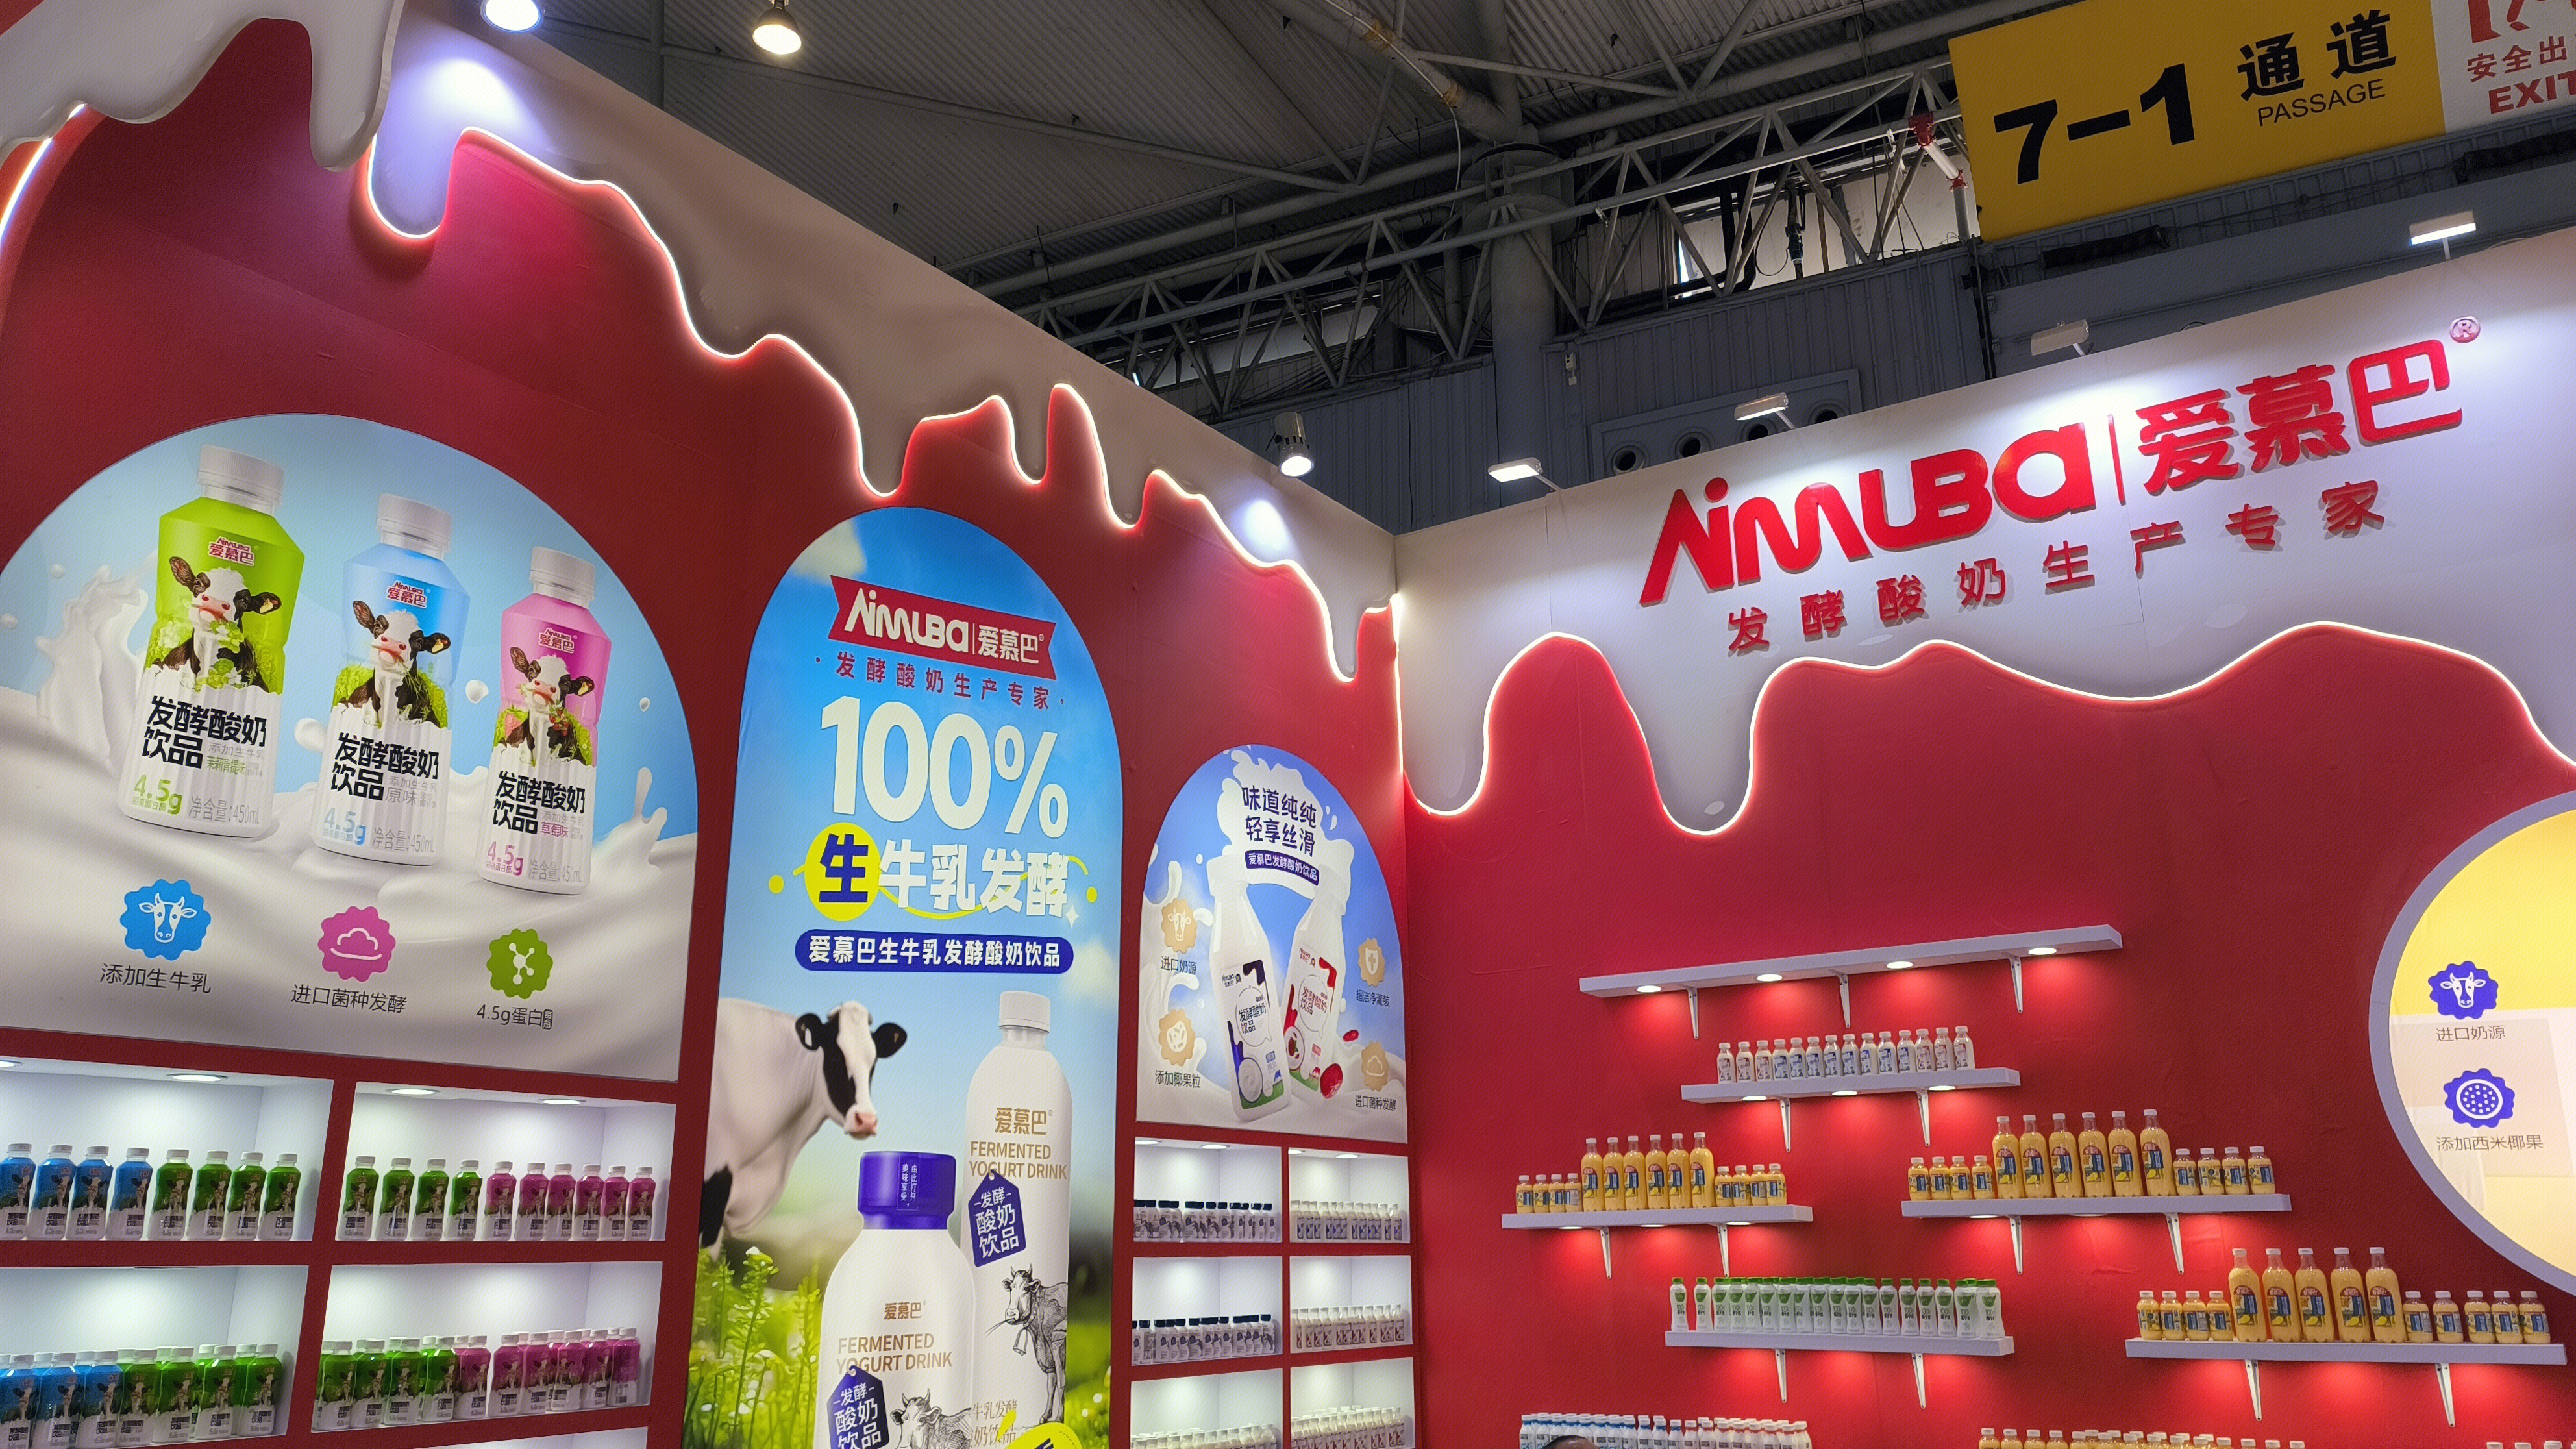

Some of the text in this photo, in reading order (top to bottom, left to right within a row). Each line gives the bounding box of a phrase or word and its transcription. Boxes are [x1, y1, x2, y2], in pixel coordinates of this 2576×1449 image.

[2236, 10, 2397, 102] 通道
[2257, 78, 2386, 126] PASSAGE
[2488, 69, 2576, 114] EXIT
[209, 543, 254, 565] 爱慕巴
[1726, 478, 2386, 656] 发酵酸奶生产专家
[387, 587, 426, 607] 爱慕巴
[835, 651, 1050, 710] 发酵酸奶生产专家
[147, 695, 267, 747] 发酵酸奶
[142, 726, 204, 769] 饮品
[208, 742, 264, 760] 添加生牛乳
[334, 732, 440, 780] 发酵酸奶
[330, 762, 384, 801] 饮品
[821, 695, 1070, 839] 100%
[134, 774, 182, 815] 4.5g
[386, 787, 417, 806] 原味
[495, 771, 586, 814] 发酵酸奶
[1241, 786, 1317, 830] 味道纯纯
[325, 807, 367, 845] 4.5g
[493, 799, 538, 835] 饮品
[540, 821, 569, 839] 草莓味
[1245, 814, 1315, 858] 轻享丝滑
[488, 841, 524, 876] 4.5g
[1248, 852, 1317, 881] 爱慕巴发酵酸奶饮品
[819, 833, 1070, 918] 生牛乳发酵
[808, 935, 1061, 968] 爱慕巴生牛乳发酵酸奶饮品
[1160, 955, 1197, 976] 进口奶源
[100, 963, 212, 994] 添加生牛乳
[290, 984, 408, 1014] 进口菌种发酵
[1239, 1002, 1267, 1022] 发酵酸奶
[1241, 1020, 1256, 1035] 饮品
[2435, 1025, 2506, 1042] 进口奶源
[1155, 1069, 1201, 1089] 添加椰果粒
[1355, 1094, 1396, 1111] 进口菌种发酵
[995, 1107, 1046, 1135] 爱慕巴
[971, 1141, 1051, 1159] FERMENTED
[2436, 1134, 2544, 1152] 添加西米椰果
[969, 1160, 1067, 1180] YOGURT DRINK
[975, 1203, 1015, 1236] 酸奶
[979, 1226, 1019, 1259] 饮品
[884, 1302, 922, 1320] 爱慕巴
[837, 1333, 934, 1354] FERMENTED
[906, 1351, 953, 1370] DRINK
[834, 1397, 878, 1435] 酸奶
[837, 1421, 882, 1449] 饮品
